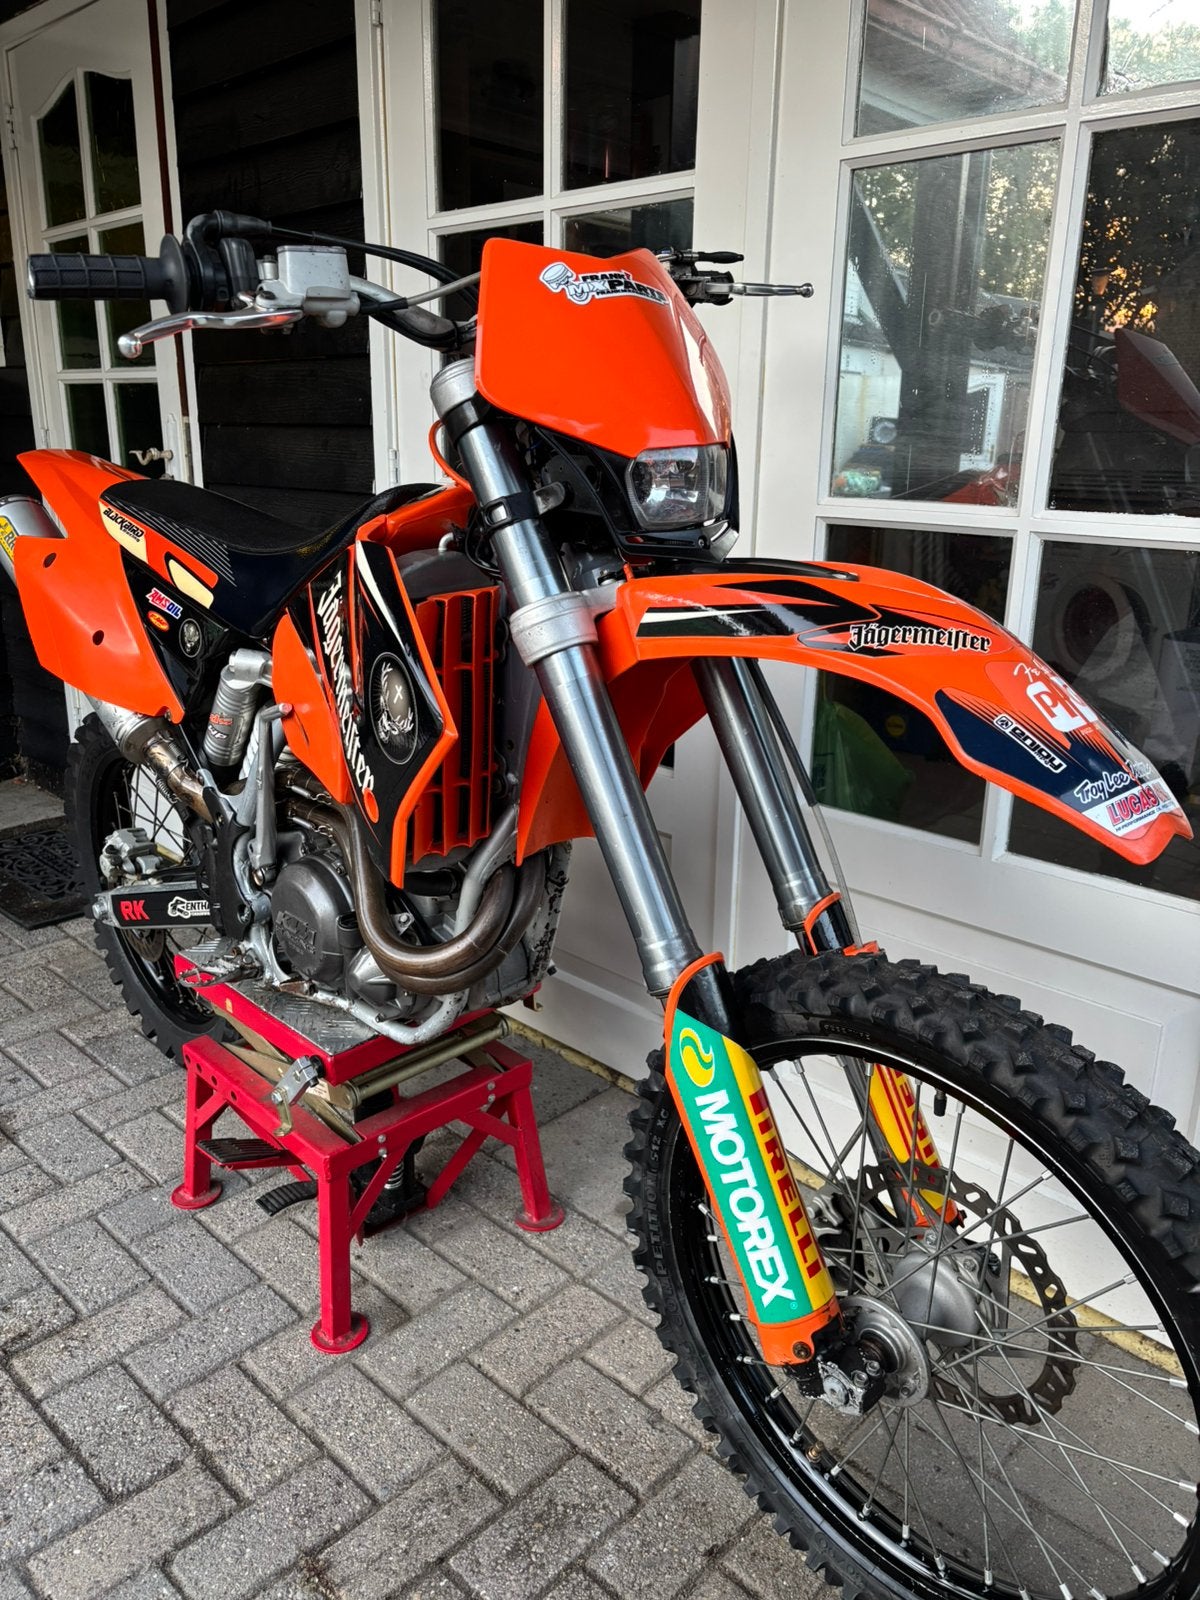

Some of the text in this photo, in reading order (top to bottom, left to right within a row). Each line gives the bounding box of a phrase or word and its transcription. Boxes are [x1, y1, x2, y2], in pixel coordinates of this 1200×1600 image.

[103, 507, 144, 537] BLACKBIRD
[148, 589, 181, 617] AMSOIL
[850, 623, 991, 652] Jägermeister
[1009, 726, 1063, 771] enjoy
[1076, 772, 1130, 803] Troy Lee
[1106, 785, 1160, 827] LUCAS
[120, 899, 149, 921] RK
[749, 1086, 822, 1279] PIRELLI
[694, 1089, 795, 1308] MOTOREX
